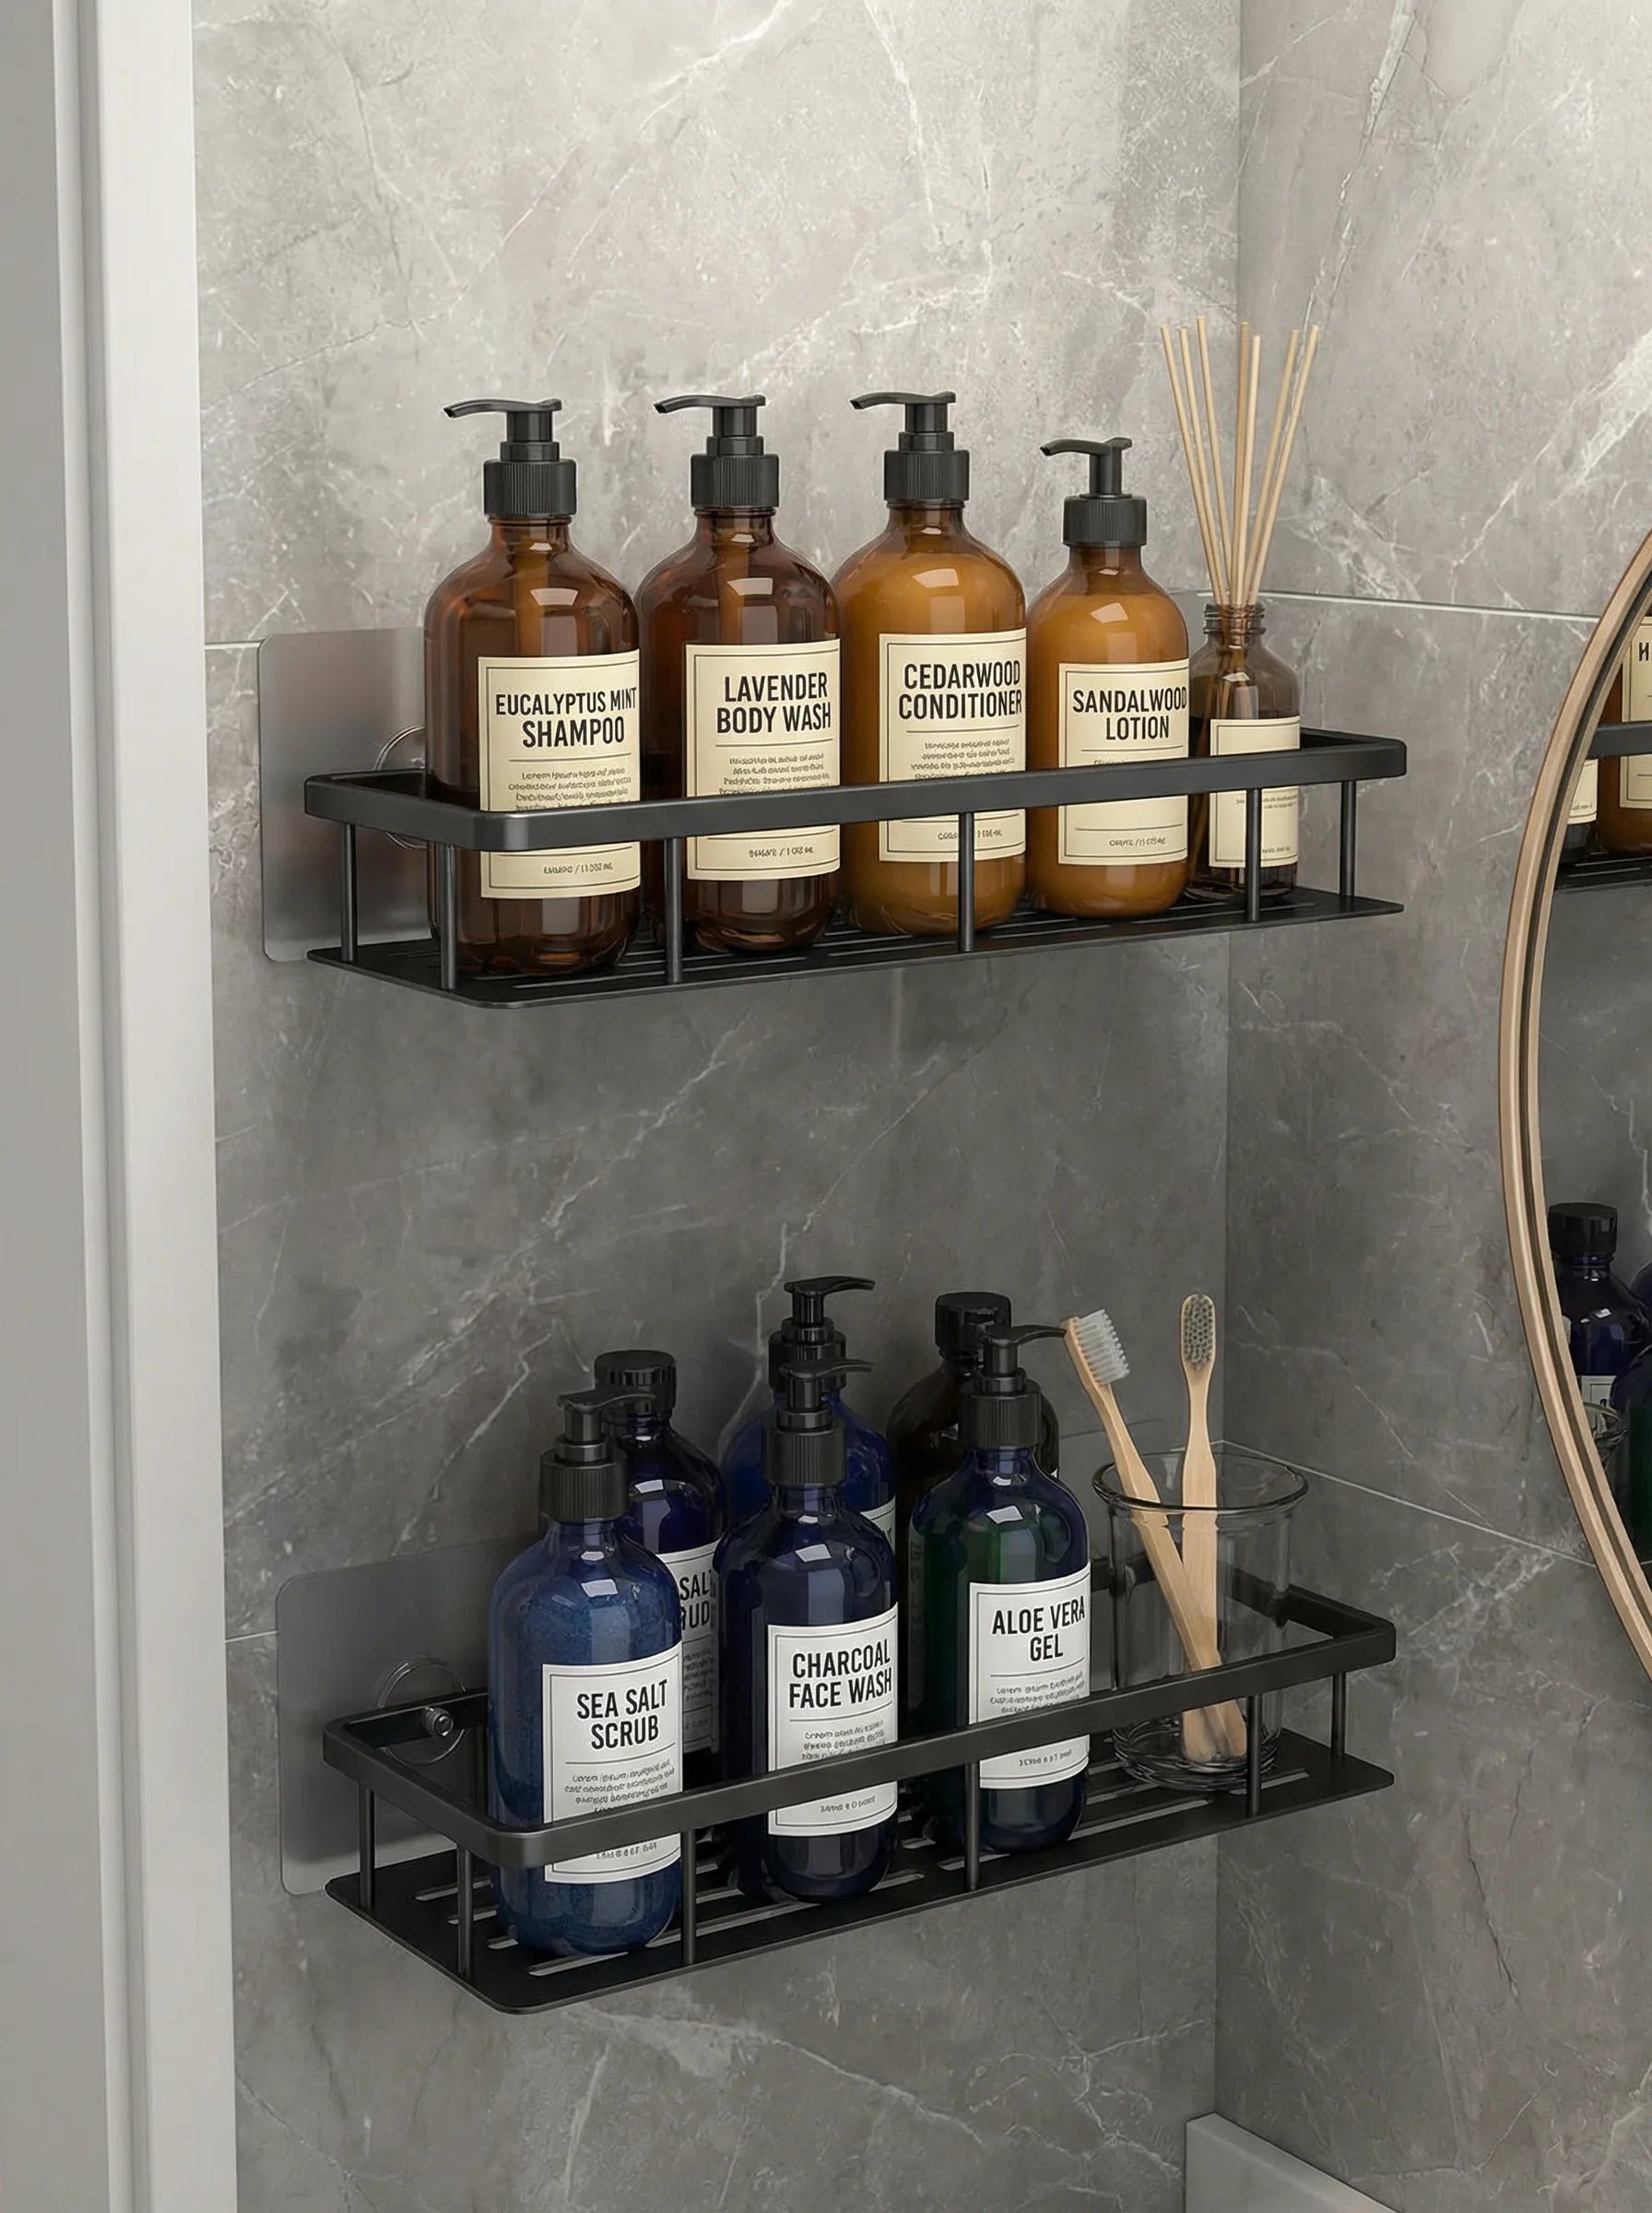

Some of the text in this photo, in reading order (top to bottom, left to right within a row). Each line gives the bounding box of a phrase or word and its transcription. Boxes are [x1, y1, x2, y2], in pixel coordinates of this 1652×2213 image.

[725, 672, 828, 703] LAVENDER
[904, 660, 1021, 690] CEDARWOOD
[496, 687, 636, 716] EUCALYPTUS MINT
[899, 689, 1022, 720] CONDITIONER
[1072, 686, 1187, 714] SANDALWOOD
[522, 716, 625, 749] SHAMPOO
[716, 702, 832, 734] BODY WASH
[1105, 715, 1170, 740] LOTION
[992, 1595, 1086, 1635] ALOE VERA
[792, 1639, 891, 1678] CHARCOAL
[1030, 1633, 1064, 1663] GEL
[576, 1679, 668, 1721] SEA SALT
[788, 1667, 893, 1709] FACE WASH
[591, 1714, 660, 1750] SCRUB
